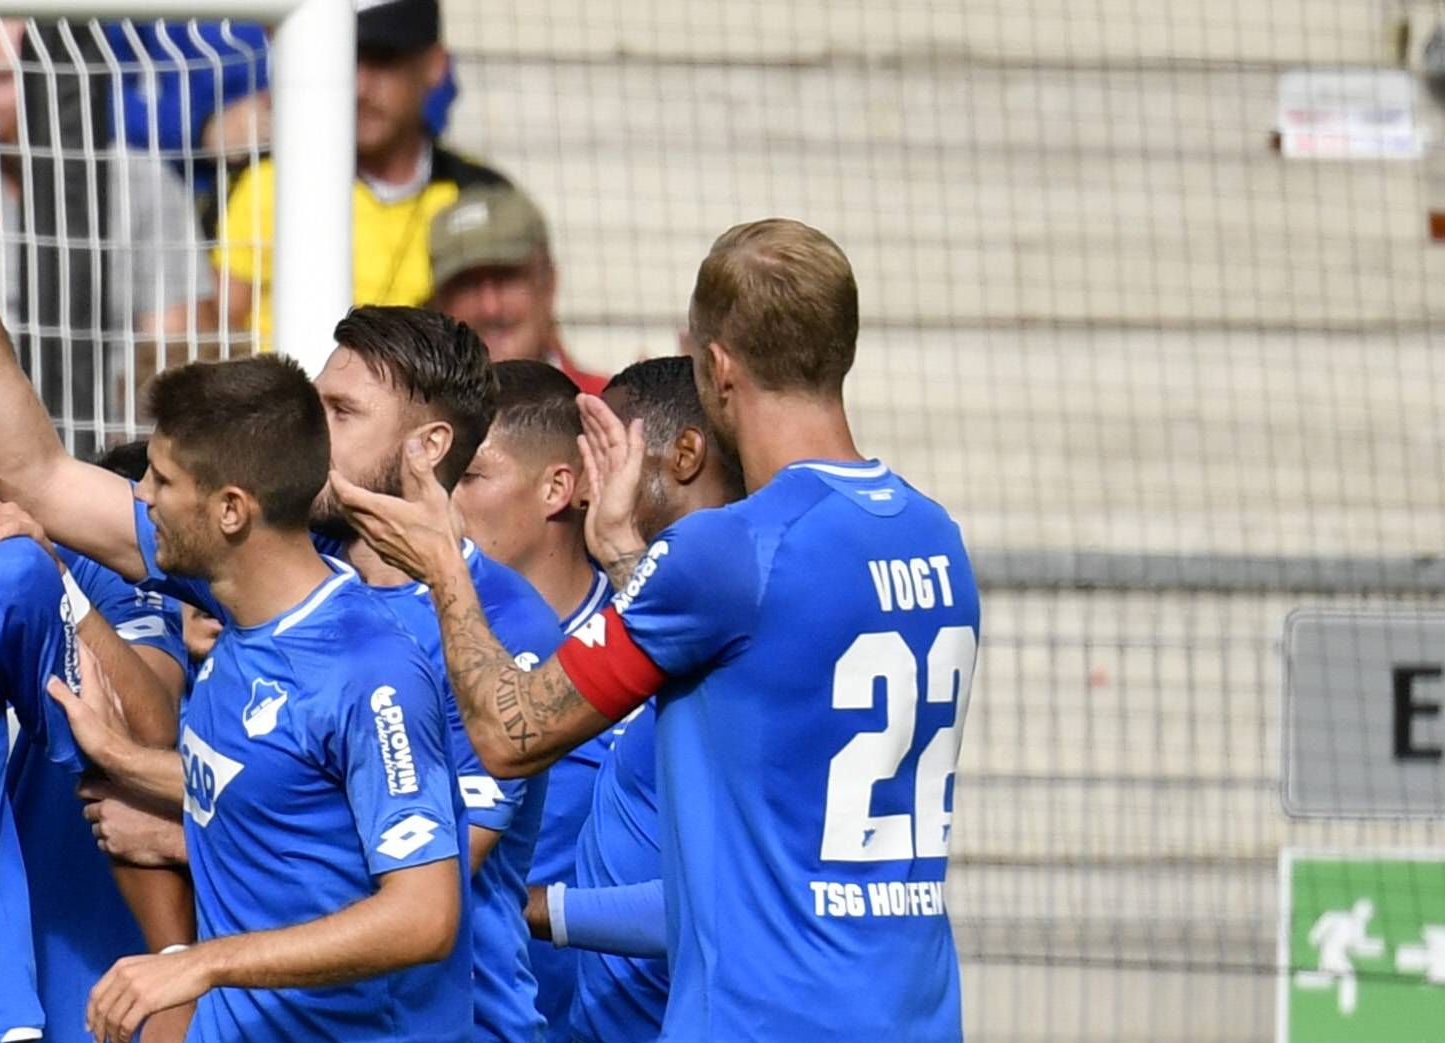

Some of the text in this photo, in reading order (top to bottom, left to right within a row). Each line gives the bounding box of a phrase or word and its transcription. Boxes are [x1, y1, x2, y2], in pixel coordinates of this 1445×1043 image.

[868, 555, 954, 612] VOGT
[820, 625, 978, 862] 22
[809, 881, 866, 917] TSG
